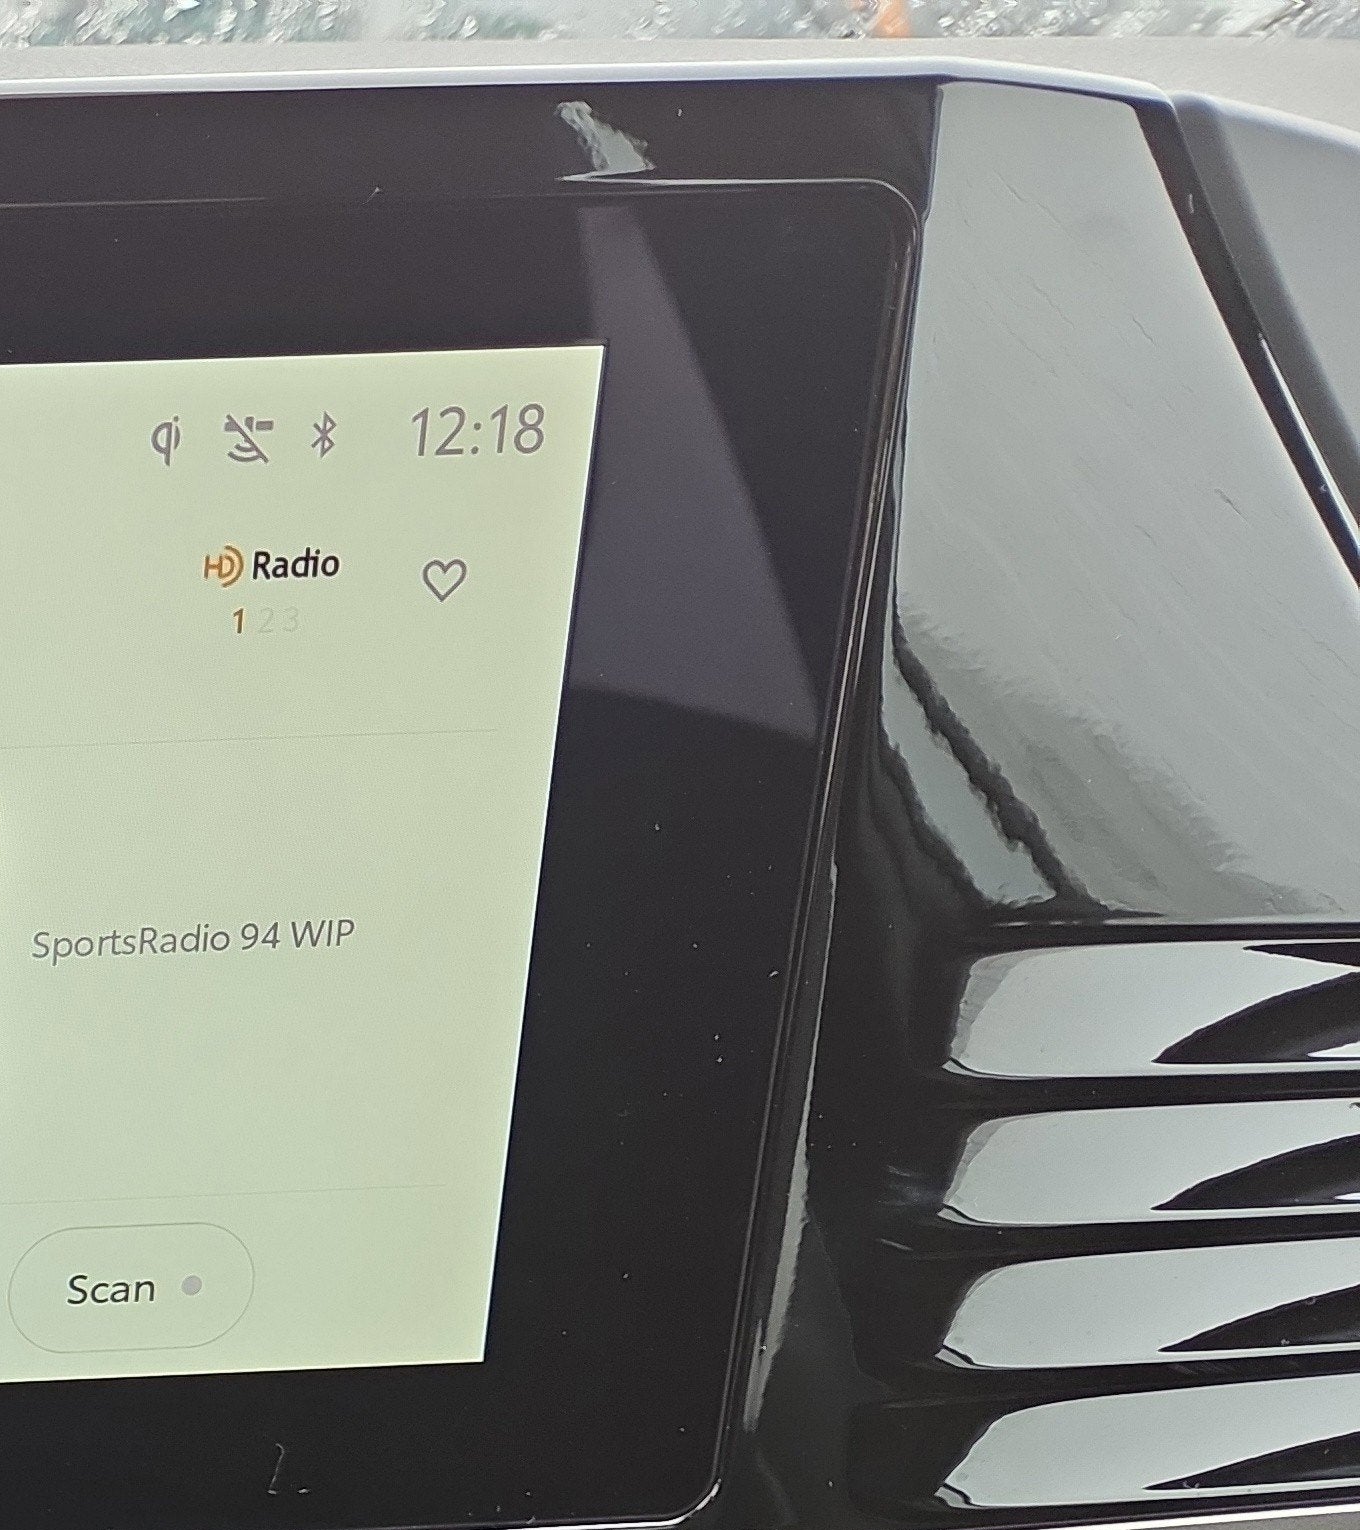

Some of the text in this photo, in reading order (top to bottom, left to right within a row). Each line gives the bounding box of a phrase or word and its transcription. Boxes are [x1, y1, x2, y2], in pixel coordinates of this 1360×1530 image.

[412, 403, 545, 457] 12:18
[252, 547, 340, 580] Radio
[32, 919, 355, 966] SportsRadio 94 WIP
[67, 1274, 155, 1305] Scan
